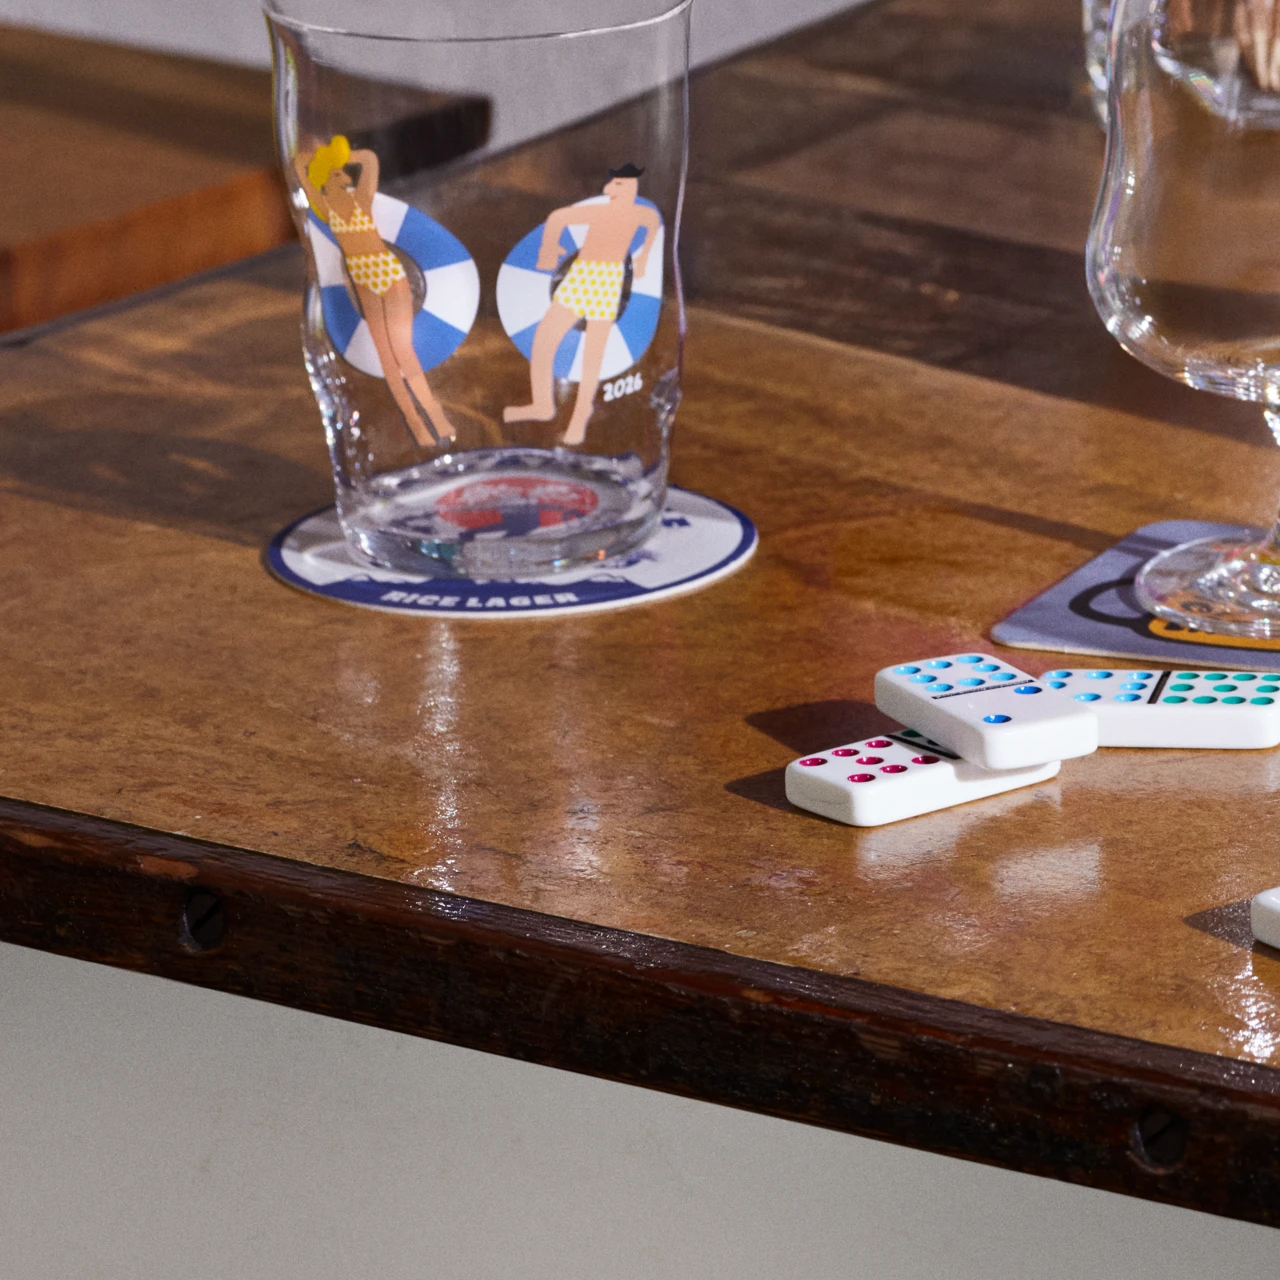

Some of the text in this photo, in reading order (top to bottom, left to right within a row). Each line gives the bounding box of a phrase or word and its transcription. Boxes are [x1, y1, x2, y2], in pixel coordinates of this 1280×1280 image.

[602, 371, 643, 402] 2026
[380, 590, 580, 608] RICE LAGER
